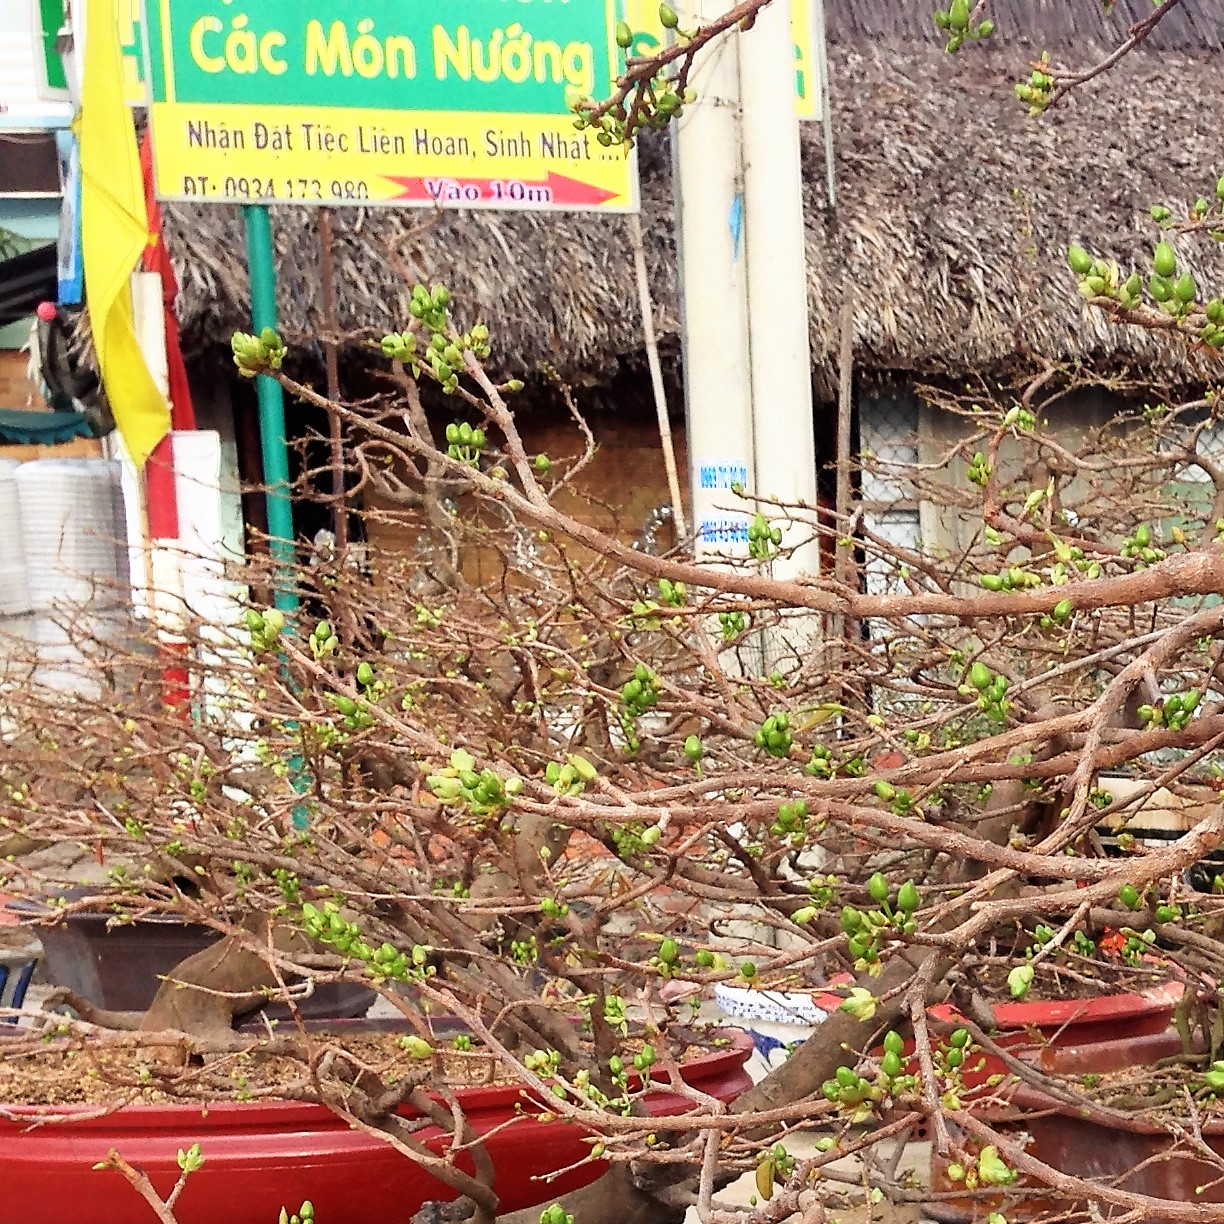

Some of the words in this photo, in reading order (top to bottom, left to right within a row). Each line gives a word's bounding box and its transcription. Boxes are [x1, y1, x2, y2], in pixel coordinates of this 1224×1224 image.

[190, 13, 288, 75] Các
[304, 18, 417, 79] Món
[432, 22, 594, 102] Nướng
[187, 120, 245, 157] Nhận
[414, 128, 477, 159] Hoan,
[486, 129, 532, 158] Sinh
[224, 176, 276, 199] 0934
[285, 178, 323, 200] 173
[330, 179, 369, 200] 980
[495, 182, 550, 203] 10m
